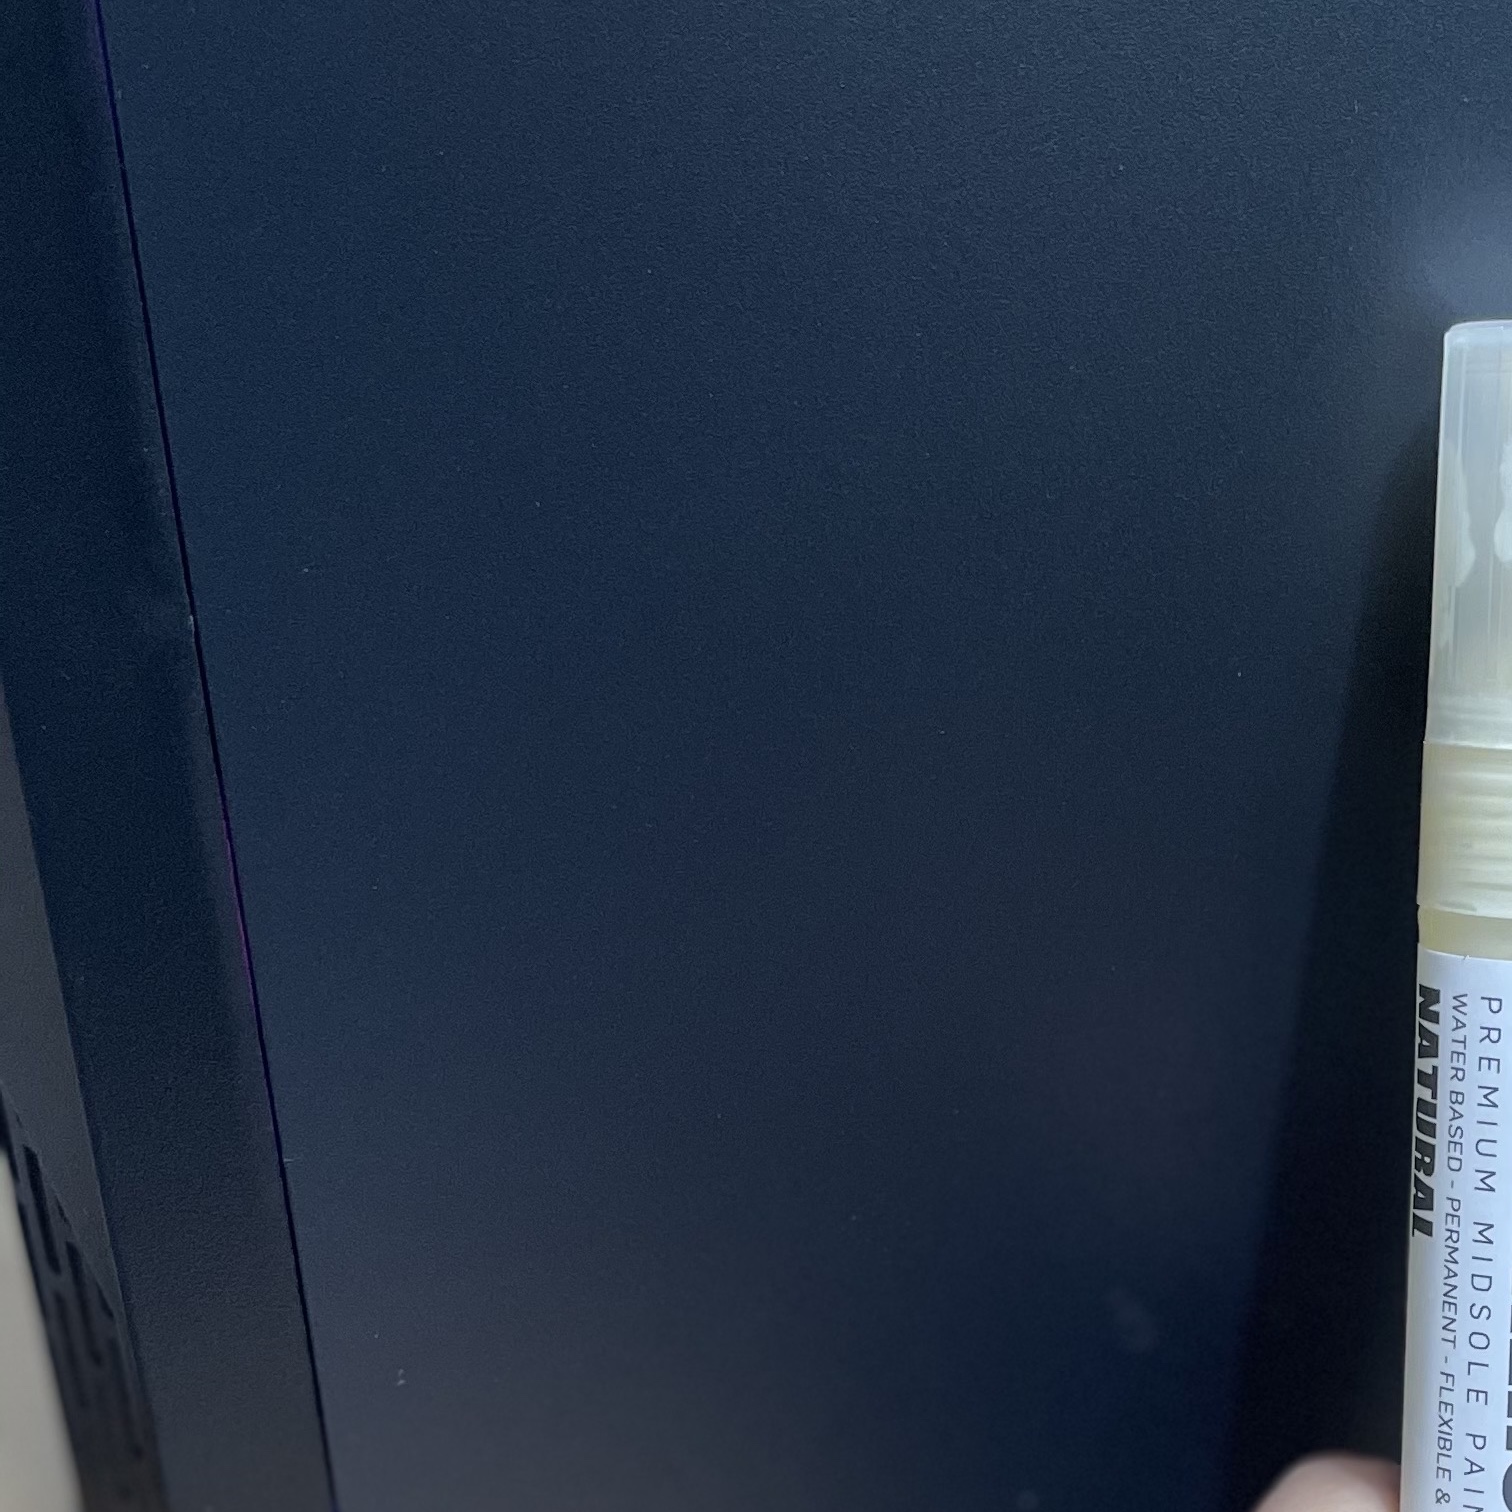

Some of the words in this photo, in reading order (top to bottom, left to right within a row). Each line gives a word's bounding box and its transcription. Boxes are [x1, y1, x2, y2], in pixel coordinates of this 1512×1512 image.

[1450, 993, 1468, 1082] WATER
[1474, 996, 1503, 1193] PREMIUM
[1412, 983, 1441, 1238] NATURAL
[1447, 1090, 1465, 1173] BASED
[1441, 1196, 1461, 1350] PERMANENT
[1467, 1221, 1495, 1406] MIDSOLE
[1436, 1371, 1455, 1481] FLEXIBLE
[1435, 1489, 1452, 1505] &
